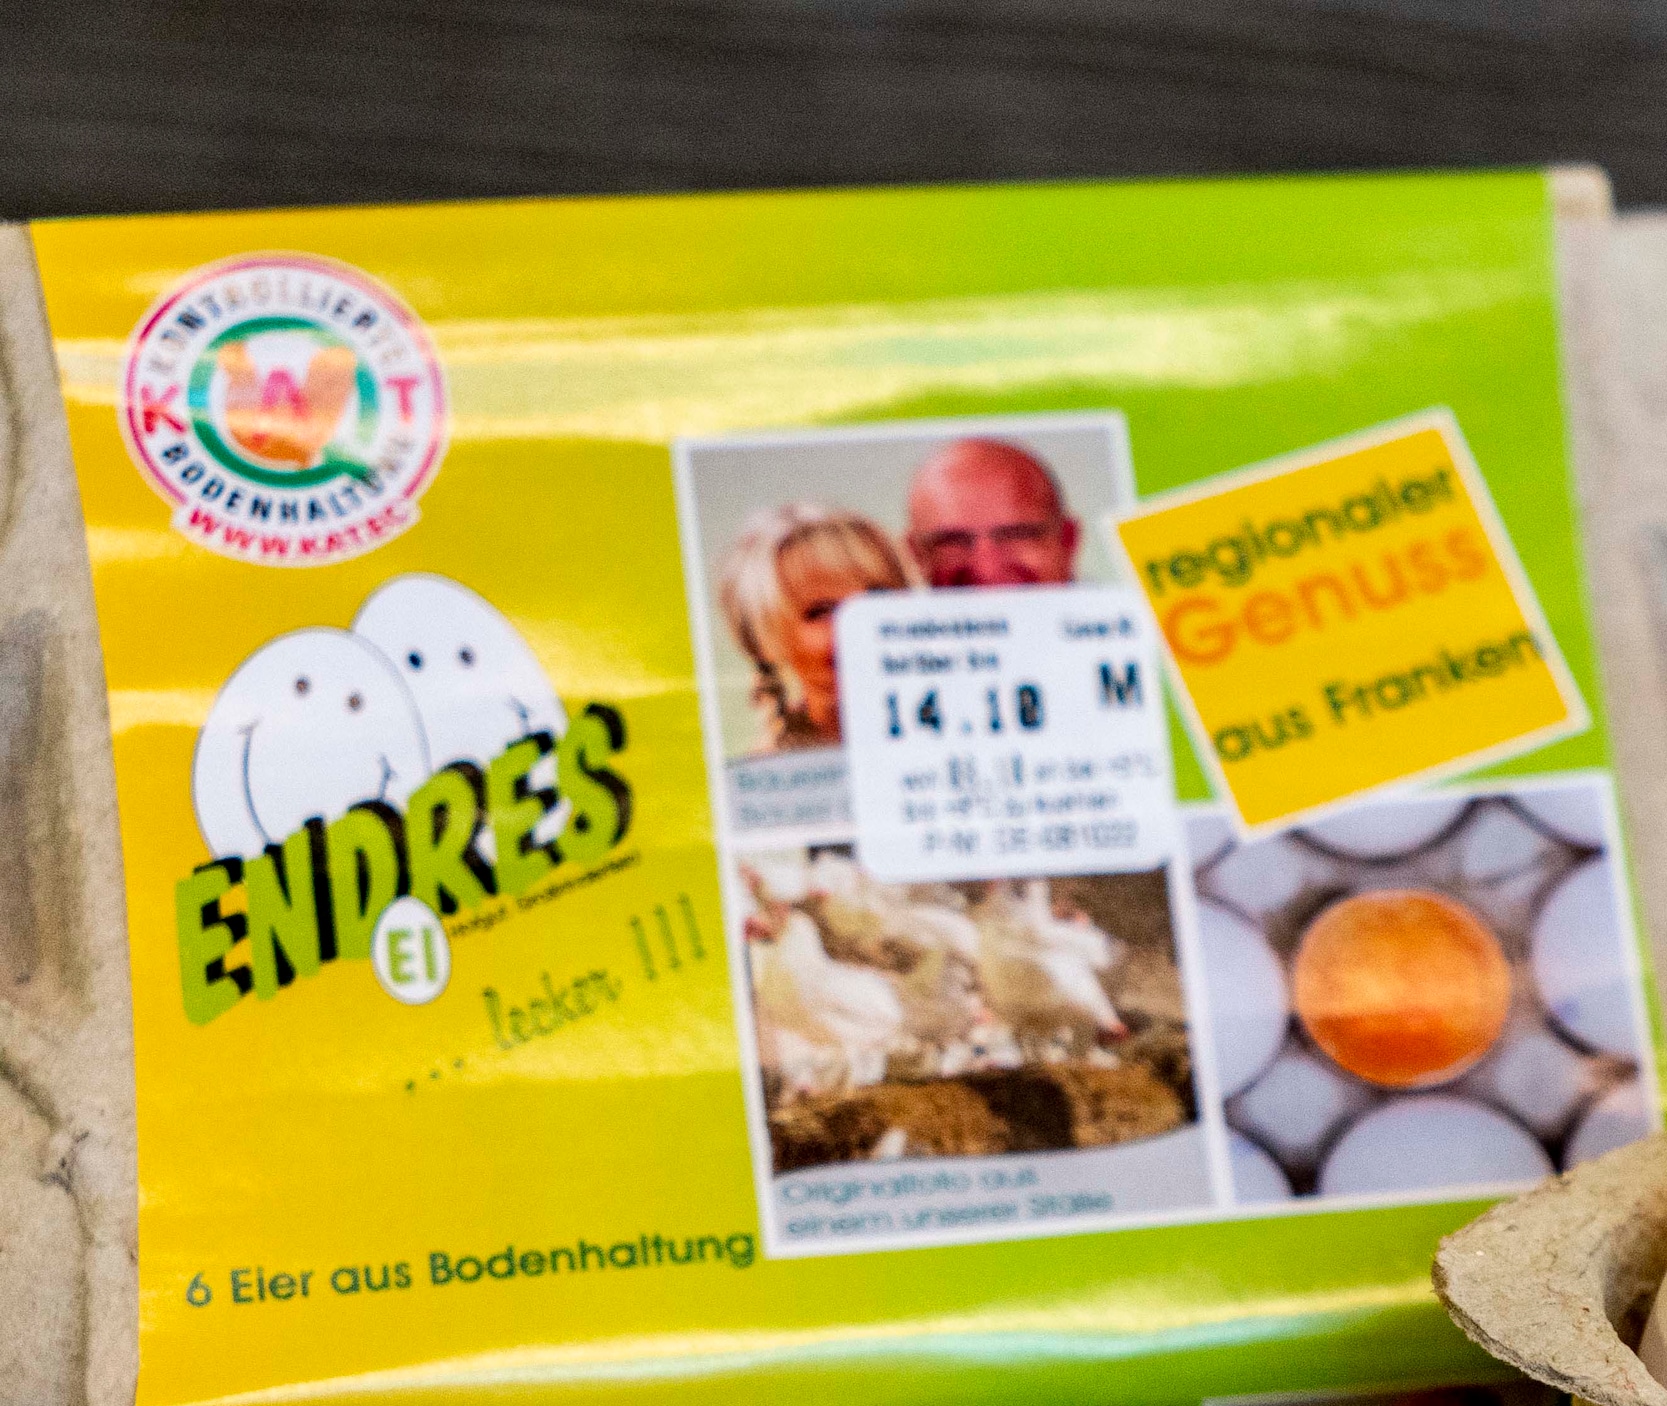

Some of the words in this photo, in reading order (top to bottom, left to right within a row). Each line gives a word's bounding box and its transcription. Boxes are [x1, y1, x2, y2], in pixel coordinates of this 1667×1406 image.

[1145, 467, 1455, 594] regionaler
[1163, 526, 1490, 668] Genuss
[887, 684, 1044, 739] 14.10
[1098, 660, 1143, 706] M
[1213, 704, 1315, 763] aus
[1321, 628, 1547, 727] Franken
[174, 702, 635, 1026] ENDRES
[386, 925, 439, 986] EI
[482, 947, 623, 1051] lecker
[185, 1270, 213, 1308] 6
[230, 1266, 313, 1305] Eier
[330, 1260, 412, 1296] aus
[428, 1231, 756, 1287] Bodenhaltung
